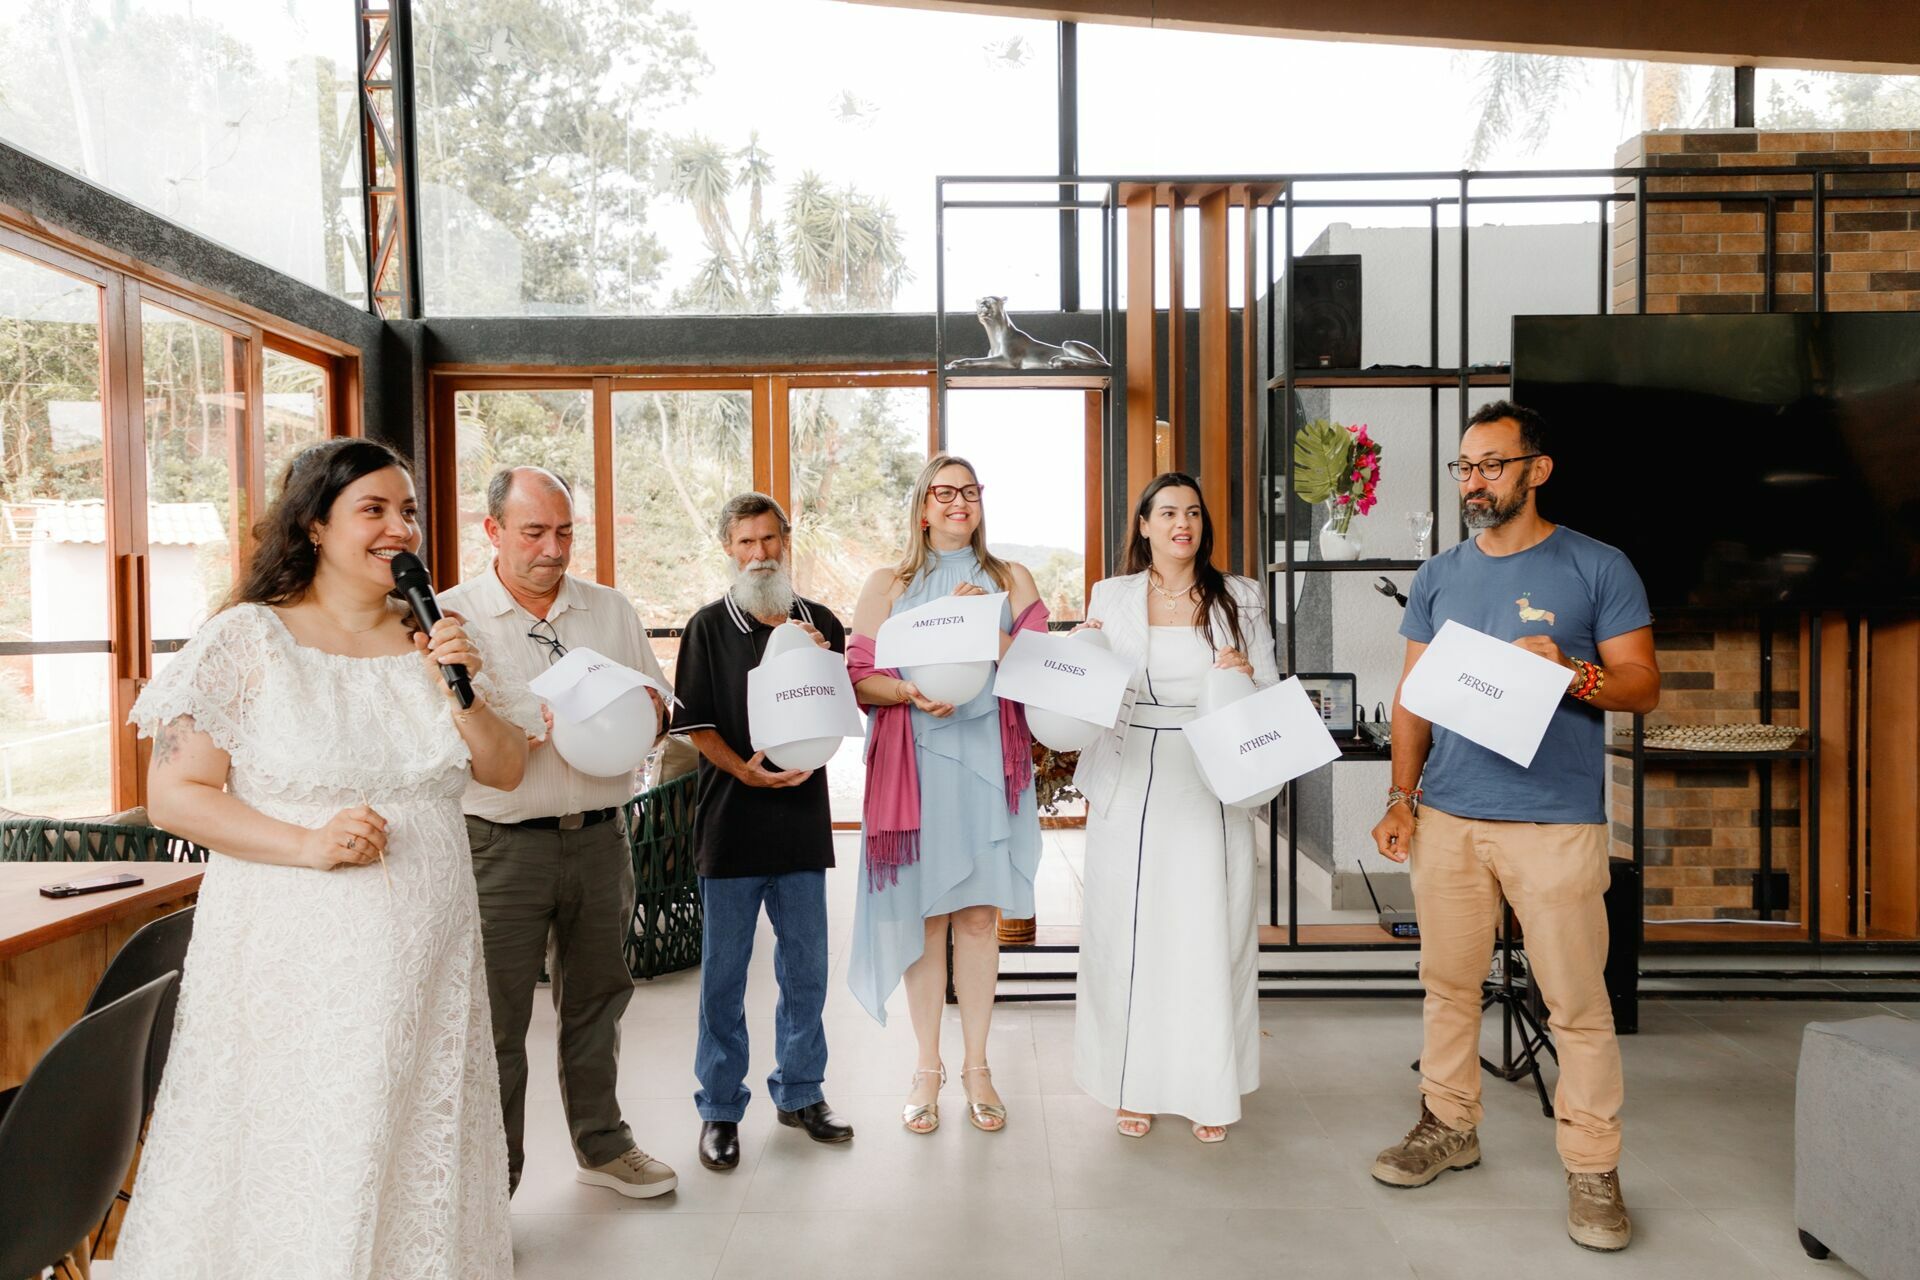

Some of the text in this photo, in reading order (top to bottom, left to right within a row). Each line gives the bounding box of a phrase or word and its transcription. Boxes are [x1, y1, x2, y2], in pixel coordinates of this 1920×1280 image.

[912, 615, 965, 628] AMETISTA
[1044, 659, 1087, 676] ULISSES
[775, 685, 836, 702] PERSÉFONE
[1457, 672, 1504, 700] PERSEU
[1240, 730, 1282, 755] ATHENA
